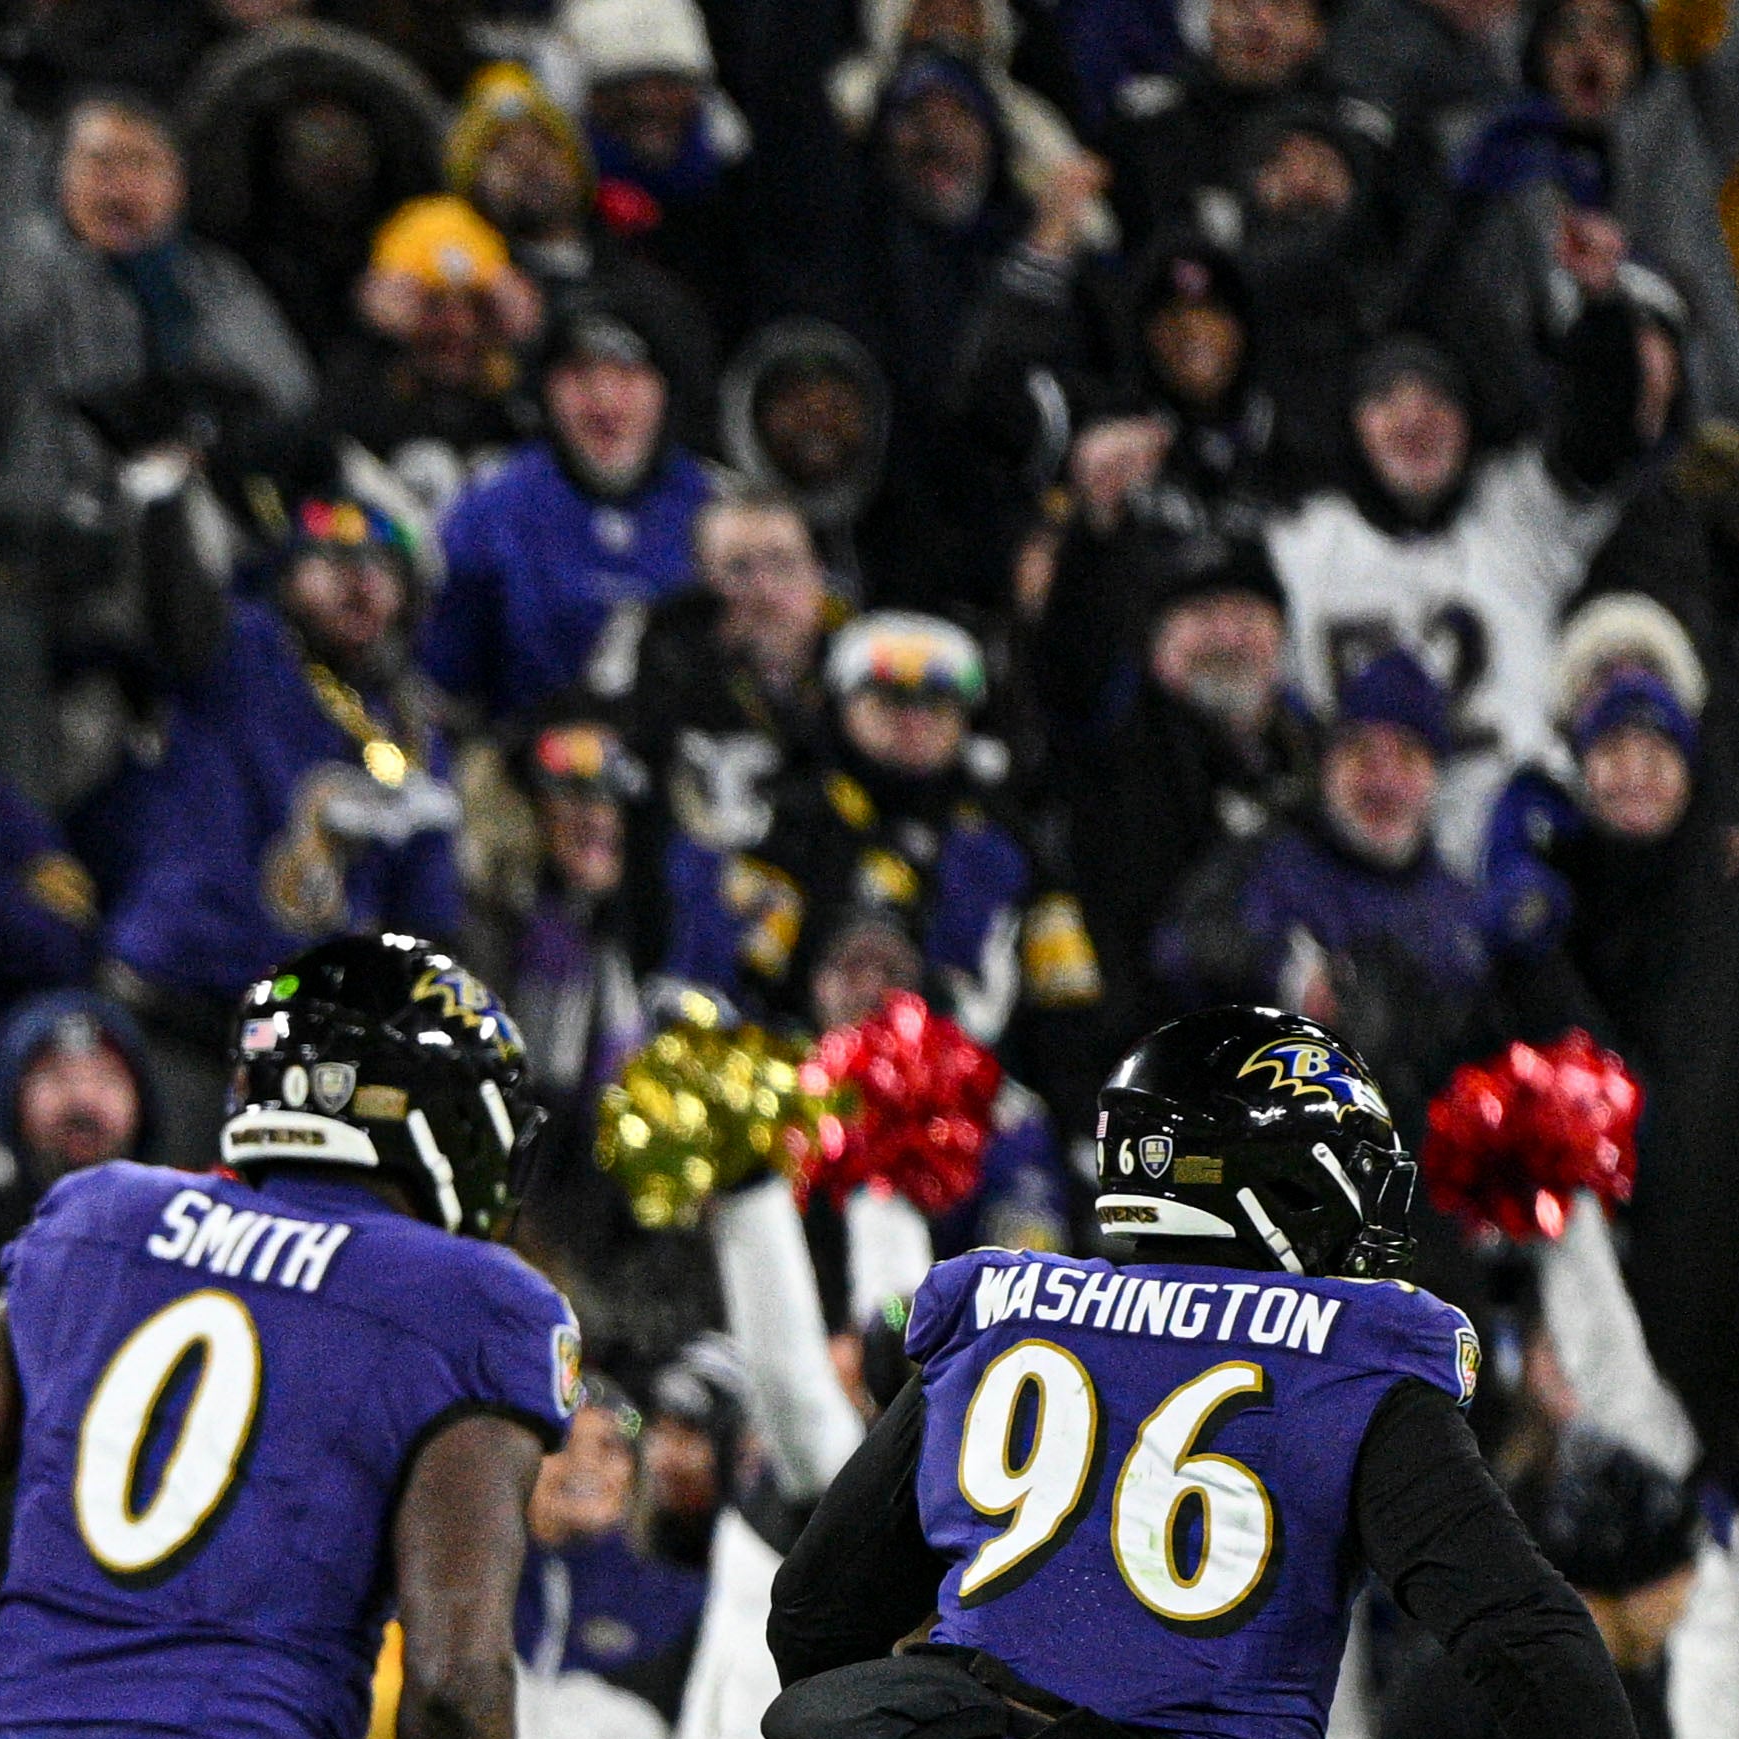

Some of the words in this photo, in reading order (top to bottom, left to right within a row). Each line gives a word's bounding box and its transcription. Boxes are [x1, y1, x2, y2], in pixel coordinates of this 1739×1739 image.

[146, 1188, 351, 1293] SMITH
[975, 1262, 1341, 1354] WASHINGTON
[74, 1287, 263, 1574] 0
[958, 1338, 1274, 1622] 96
